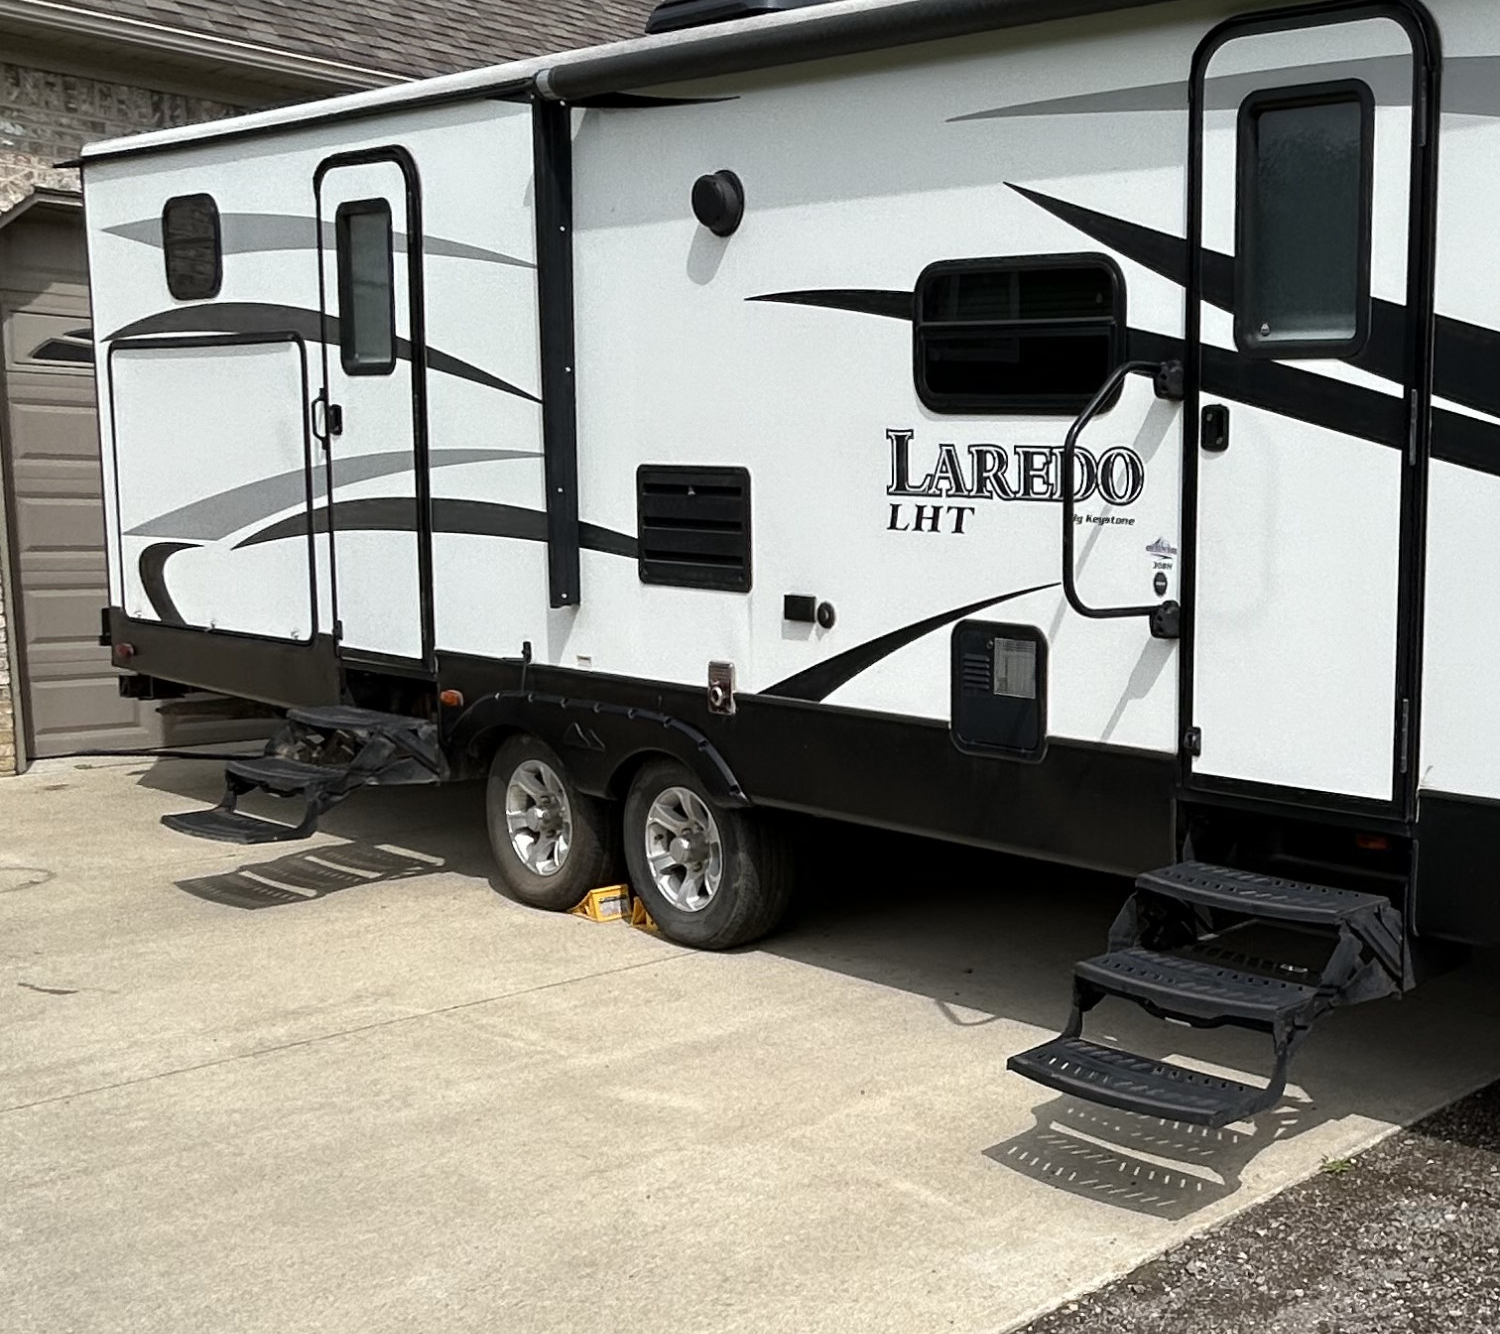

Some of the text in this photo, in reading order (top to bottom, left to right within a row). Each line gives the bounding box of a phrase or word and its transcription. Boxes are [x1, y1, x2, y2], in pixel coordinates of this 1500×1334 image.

[885, 428, 1145, 506] LAREDO
[886, 503, 976, 534] LHT
[1085, 515, 1136, 526] Keystone
